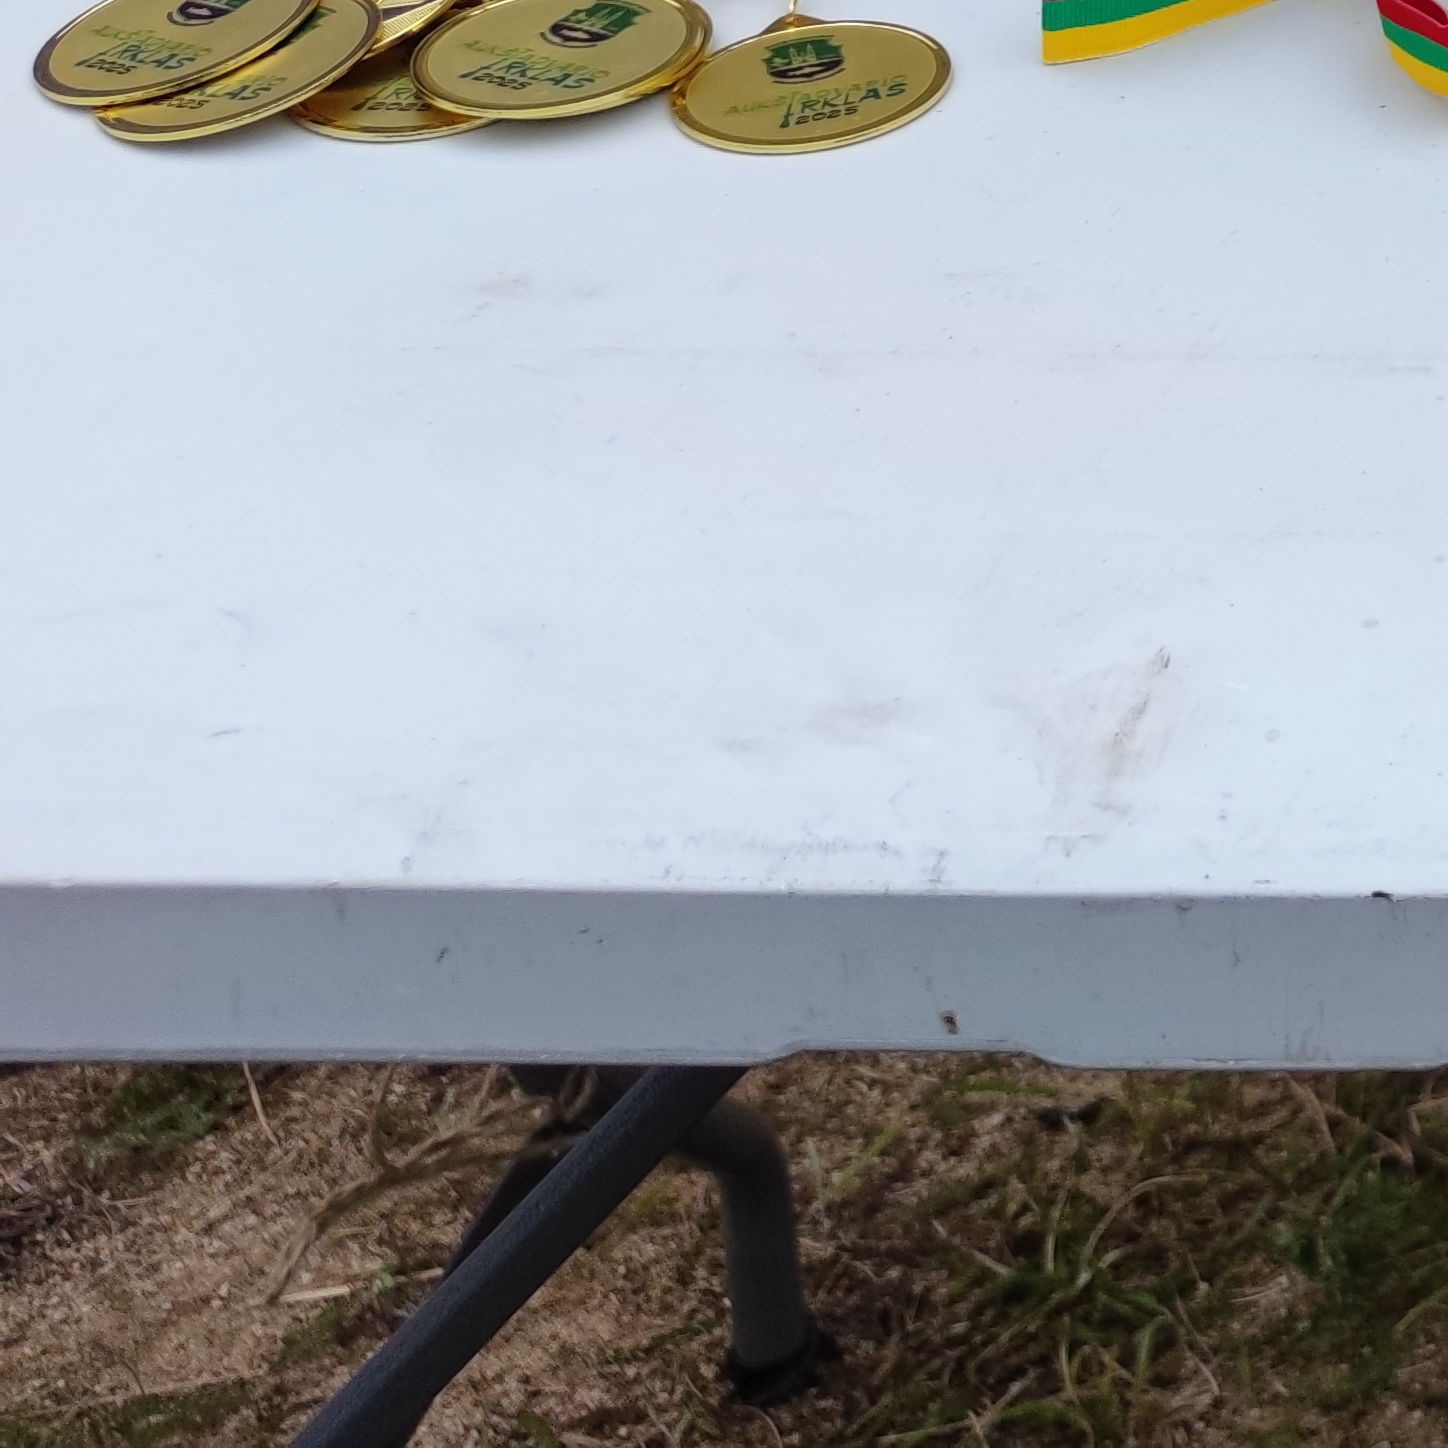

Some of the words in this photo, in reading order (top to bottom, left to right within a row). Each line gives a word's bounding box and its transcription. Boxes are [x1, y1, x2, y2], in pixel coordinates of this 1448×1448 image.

[85, 58, 138, 75] 2025
[458, 57, 597, 89] IRKLAS
[472, 72, 533, 90] 2025
[366, 101, 432, 112] 2025
[779, 82, 909, 129] IRKLAS
[795, 106, 859, 125] 2025
